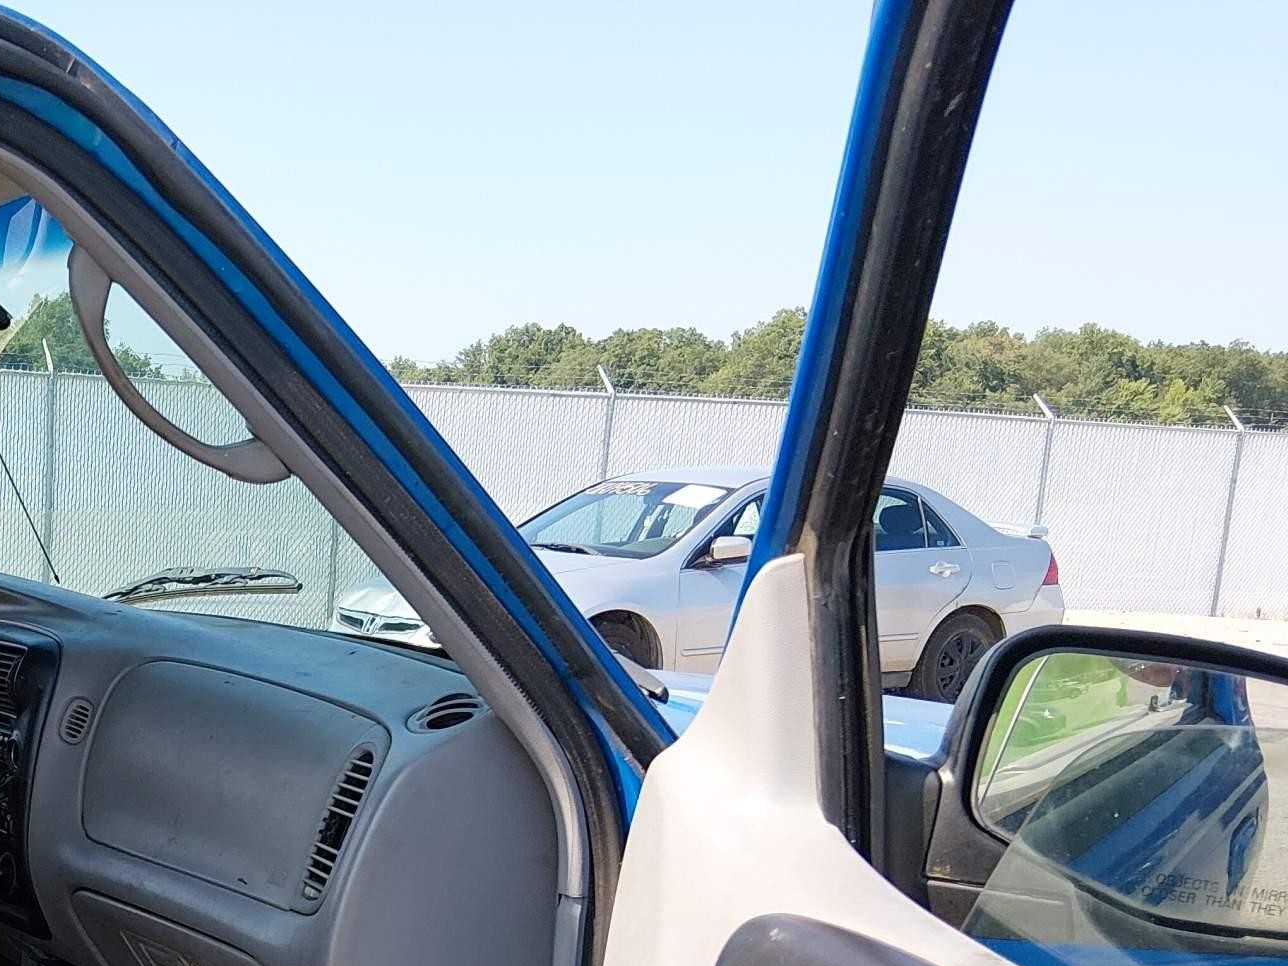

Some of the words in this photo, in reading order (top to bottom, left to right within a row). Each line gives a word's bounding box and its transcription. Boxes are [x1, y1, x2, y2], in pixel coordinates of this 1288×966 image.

[1156, 873, 1220, 892] OBJECTS
[1205, 895, 1243, 910] THAN
[1248, 901, 1288, 917] THEY
